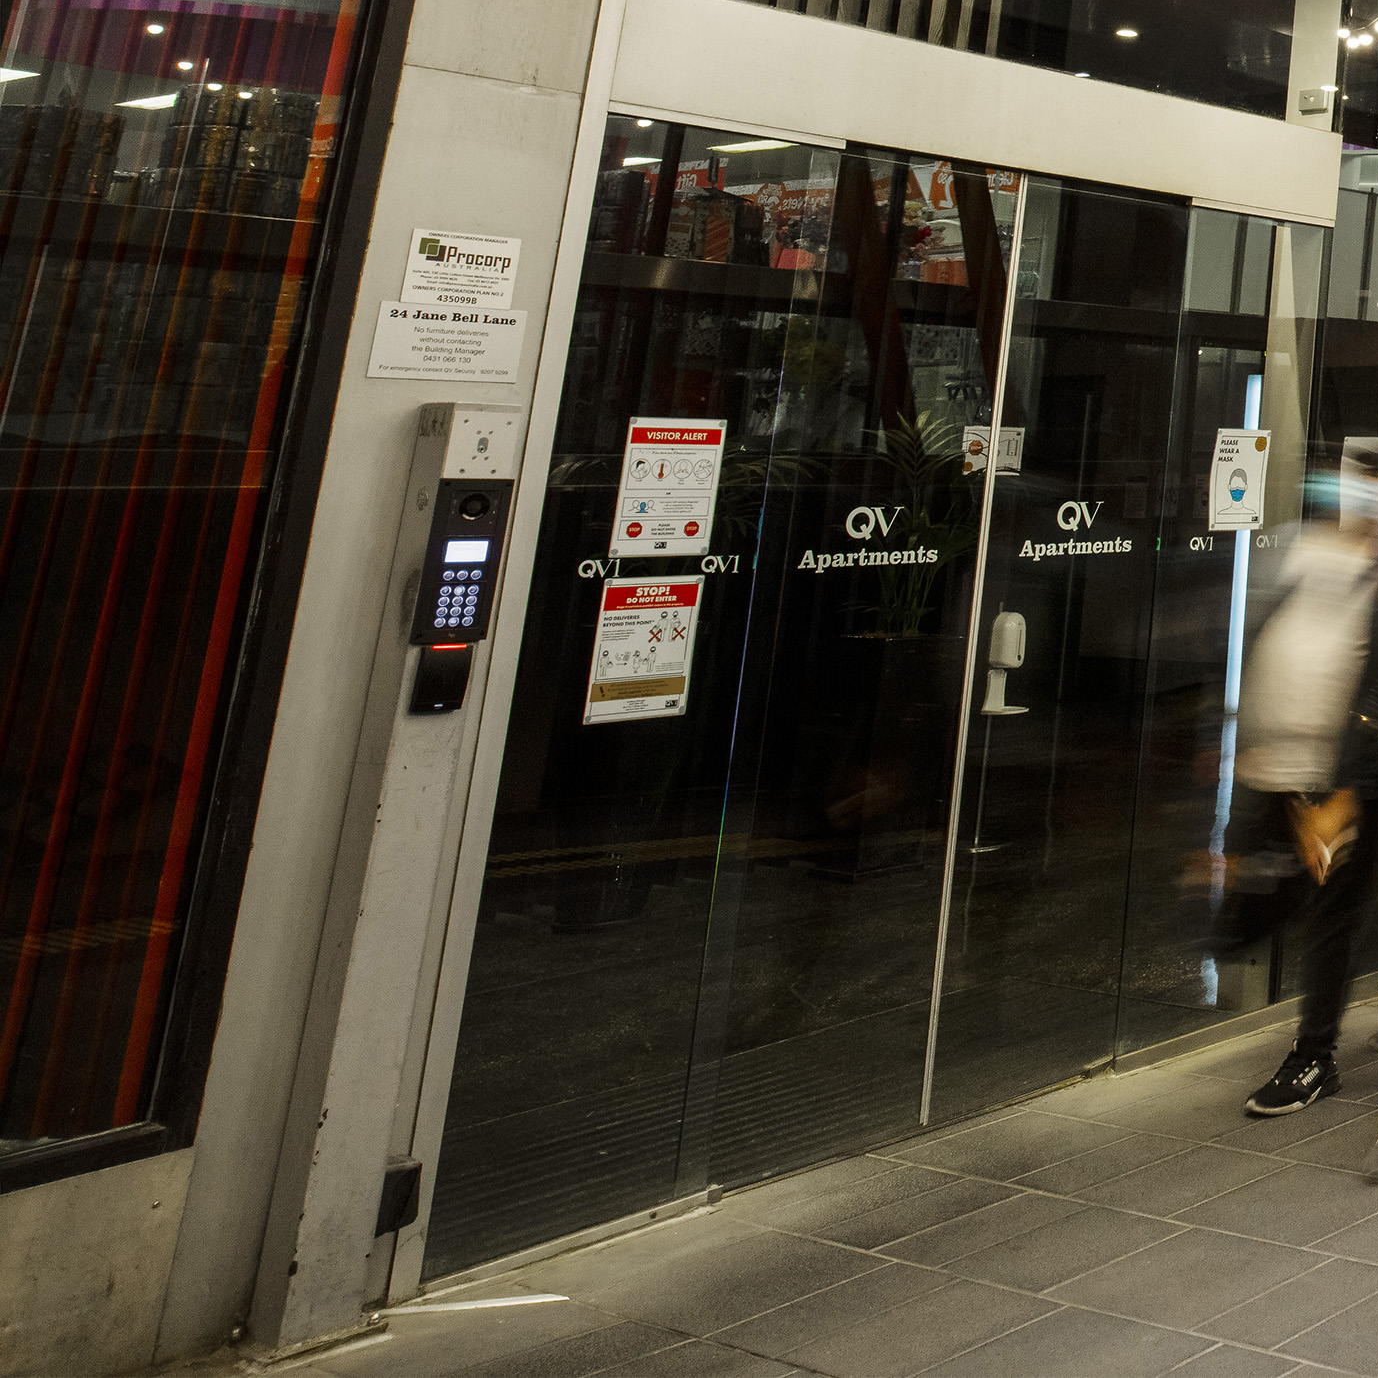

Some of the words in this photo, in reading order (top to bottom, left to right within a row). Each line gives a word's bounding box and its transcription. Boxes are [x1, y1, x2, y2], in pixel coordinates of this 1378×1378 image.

[446, 246, 511, 273] Procorp
[435, 263, 499, 272] AUSTRALIA
[437, 286, 475, 294] CORPORATION
[437, 295, 477, 304] 435099B
[390, 309, 408, 319] 24
[413, 310, 447, 321] Jane
[451, 312, 479, 322] Bell
[483, 315, 517, 325] Lane
[426, 327, 455, 335] furniture
[446, 338, 482, 346] contacting
[425, 346, 453, 354] Building
[455, 348, 485, 356] Manager
[647, 432, 680, 440] VISITOR
[845, 506, 904, 540] QV
[1056, 501, 1104, 531] QV
[1019, 536, 1132, 561] Apartments
[1190, 536, 1213, 551] QV1
[1256, 535, 1278, 548] QV1
[700, 555, 739, 574] QV1
[798, 545, 938, 573] Apartments
[578, 559, 620, 578] QV1
[636, 586, 670, 596] STOP!
